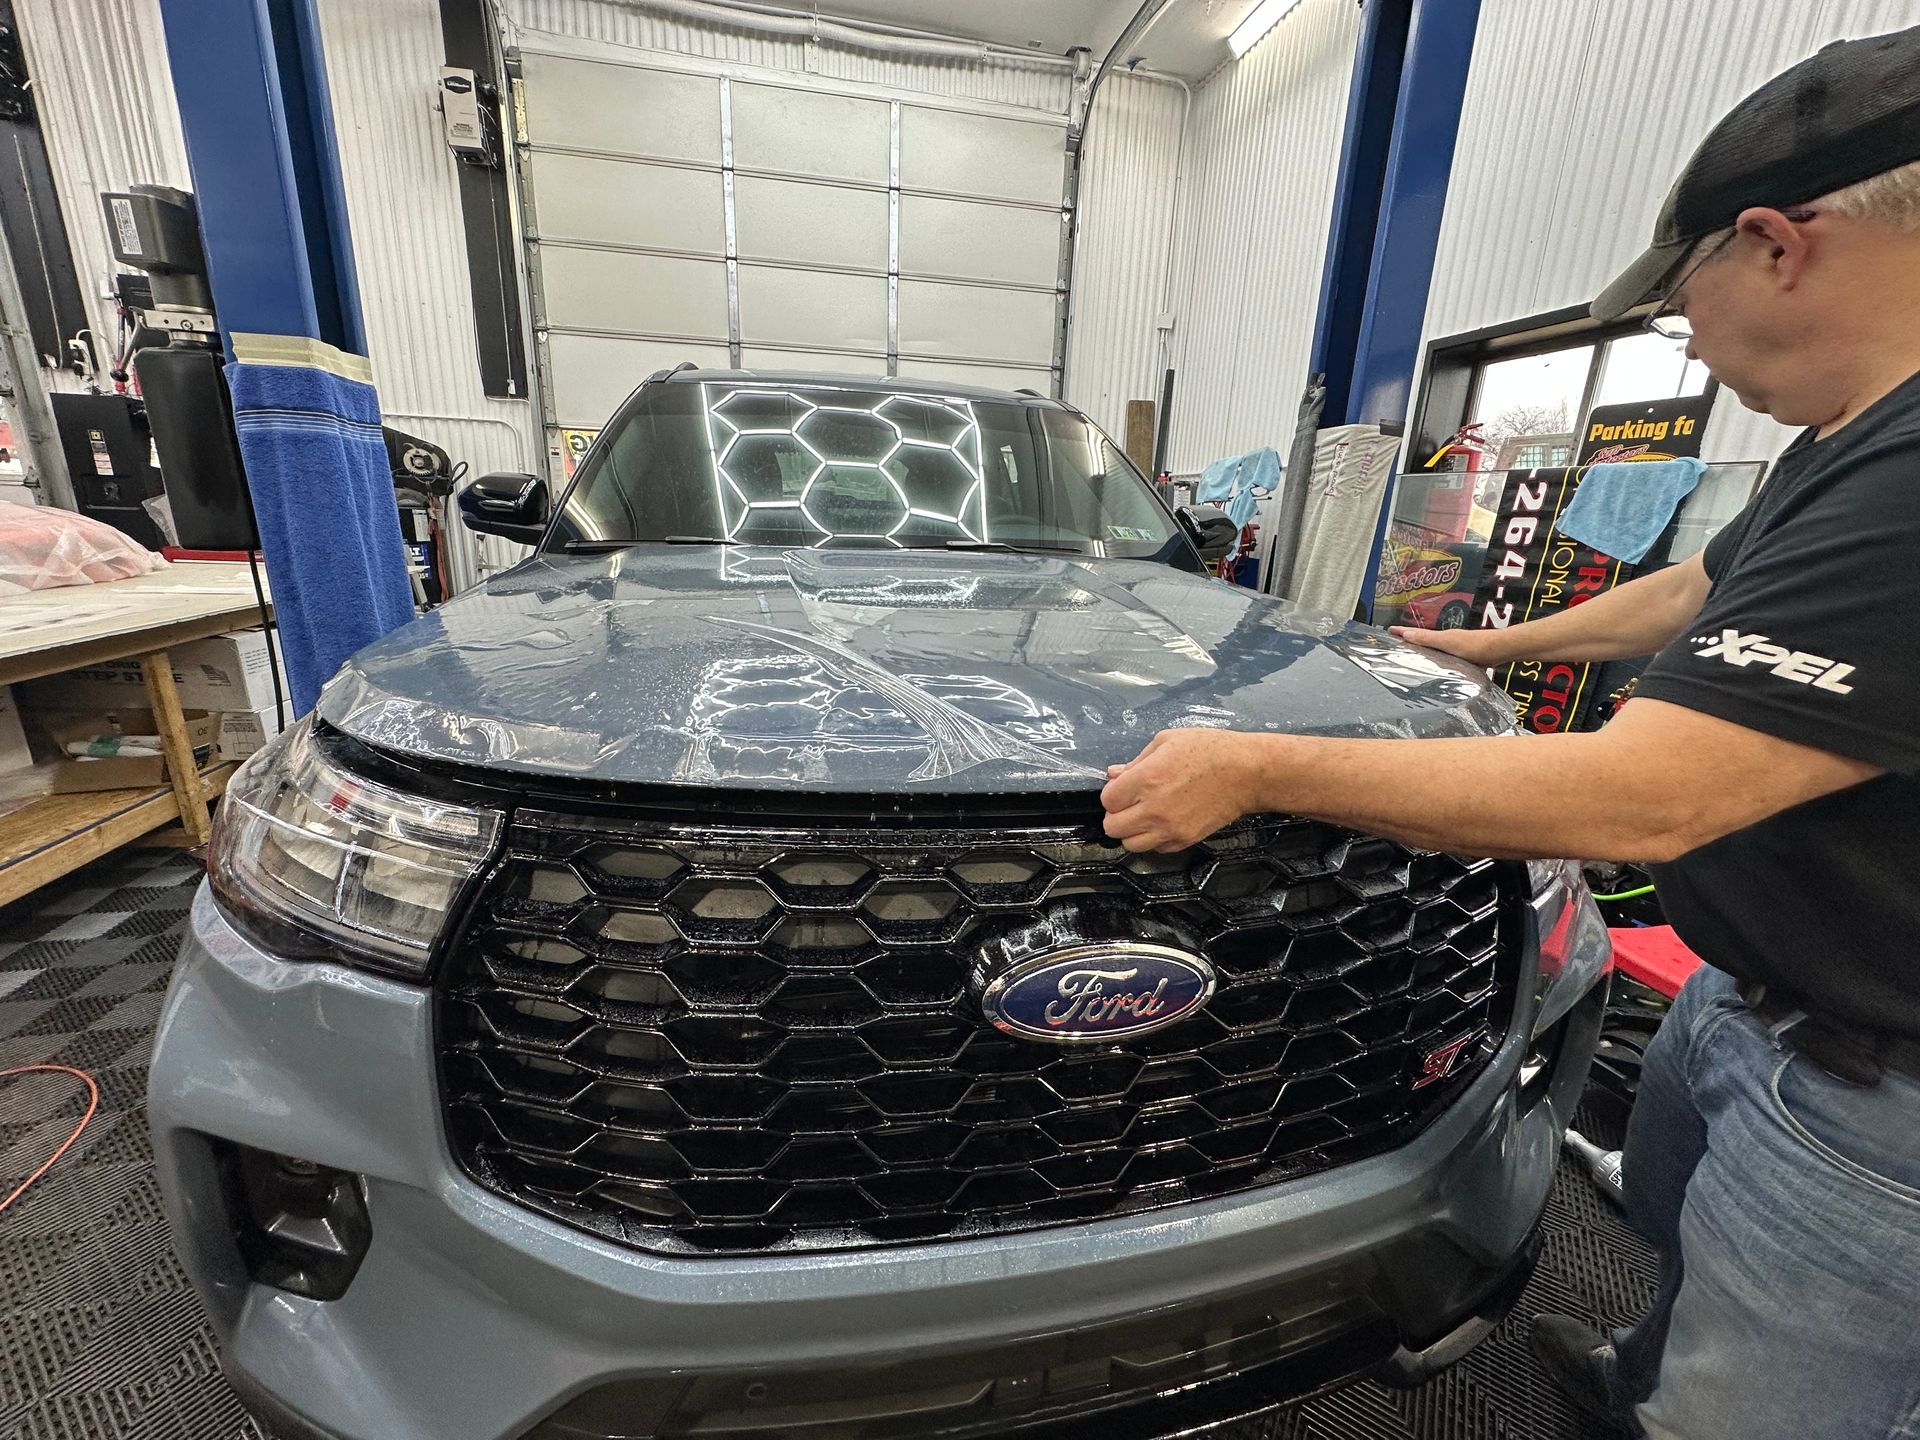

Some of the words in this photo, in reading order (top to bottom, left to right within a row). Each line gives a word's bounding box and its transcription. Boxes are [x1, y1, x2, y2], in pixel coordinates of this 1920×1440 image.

[1589, 419, 1669, 442] Parking
[1374, 561, 1459, 598] otectors
[1539, 534, 1578, 608] IONAL
[1693, 629, 1856, 695] XPEL
[1044, 967, 1168, 1026] Ford
[1411, 1032, 1472, 1091] ST
